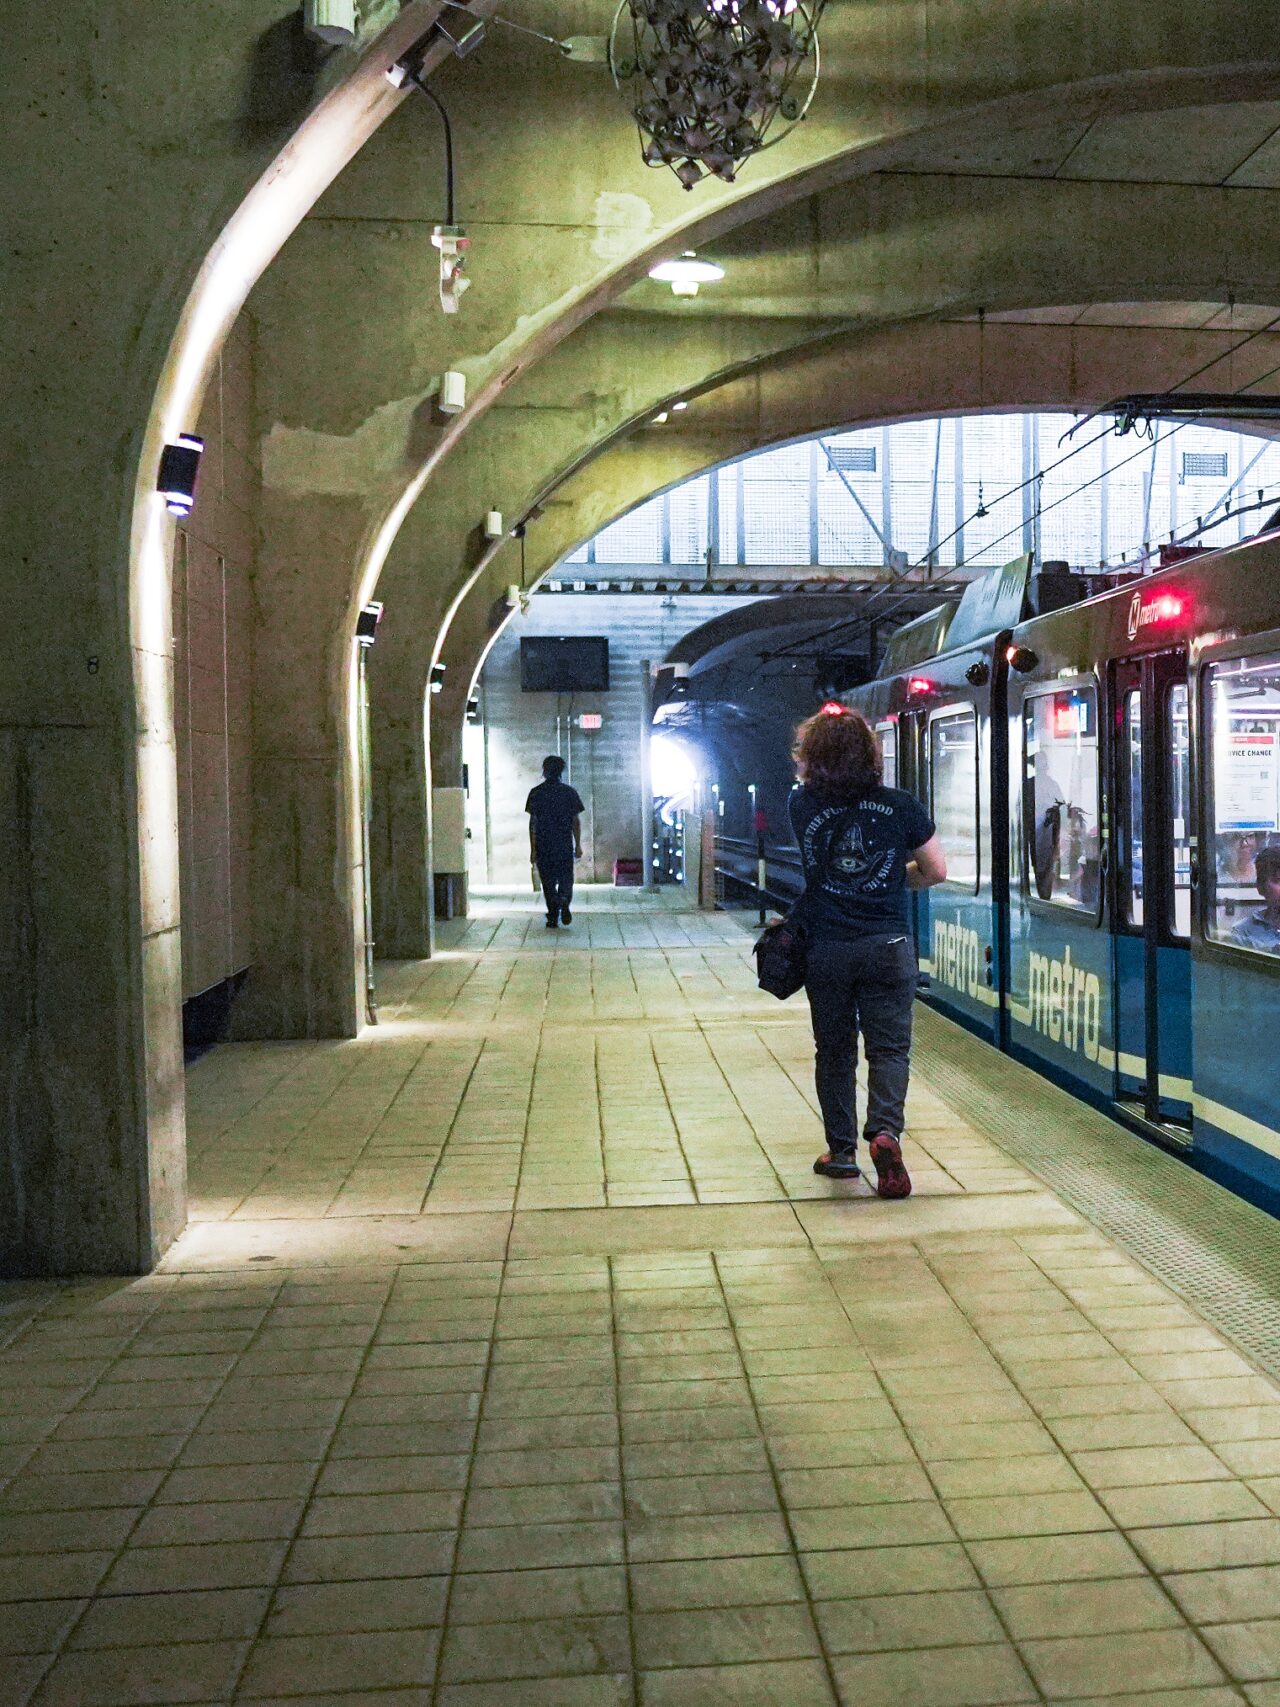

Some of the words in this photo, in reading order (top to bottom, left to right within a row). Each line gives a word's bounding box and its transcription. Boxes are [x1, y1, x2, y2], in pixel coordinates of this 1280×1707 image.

[859, 800, 894, 816] HOOD
[934, 910, 979, 998] metro
[1028, 945, 1100, 1062] metro
